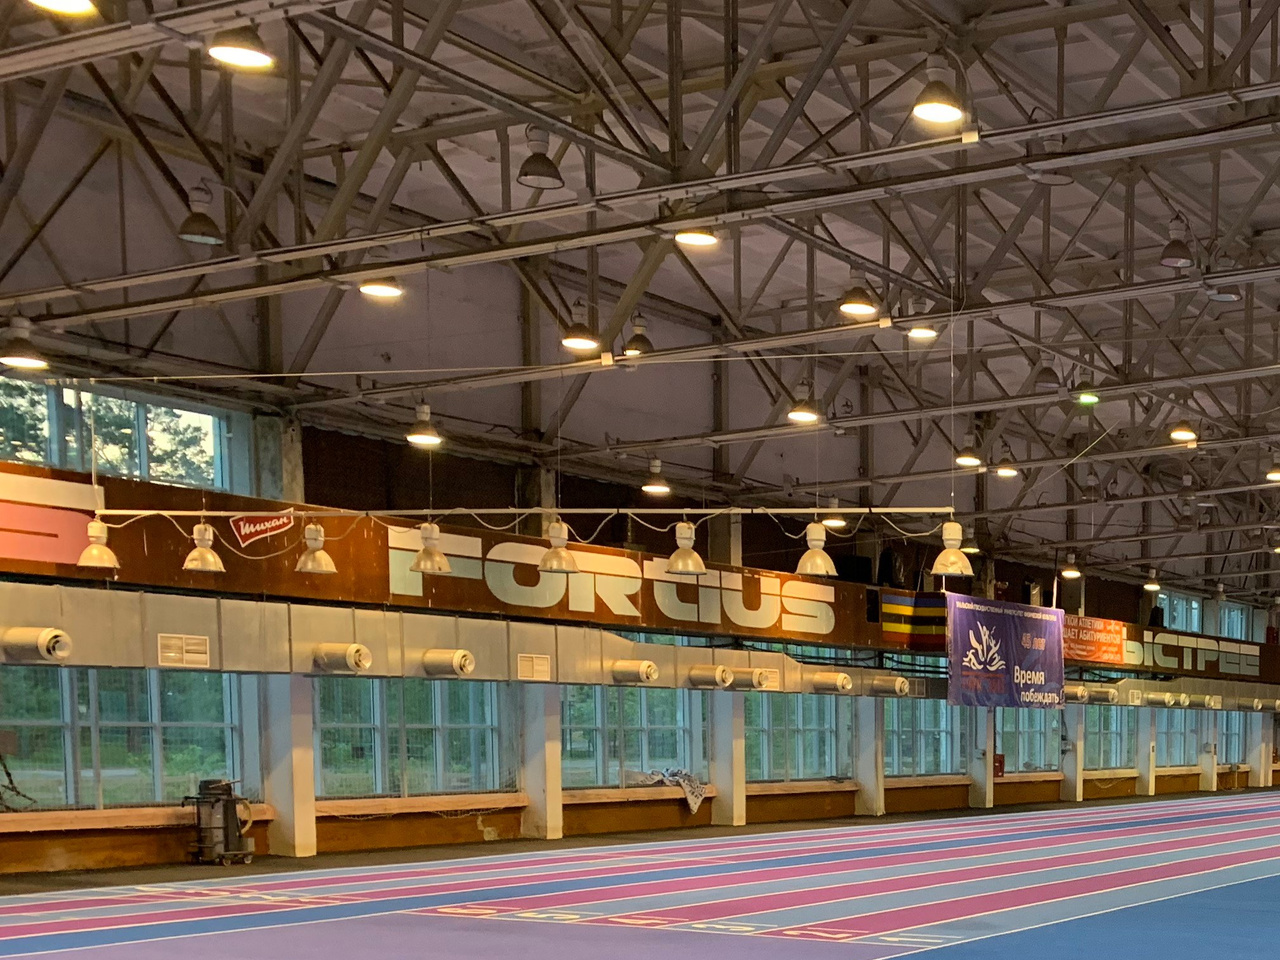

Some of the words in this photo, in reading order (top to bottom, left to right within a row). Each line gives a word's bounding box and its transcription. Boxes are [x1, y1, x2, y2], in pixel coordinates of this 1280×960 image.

[388, 526, 833, 634] FORTIUS
[1122, 626, 1260, 676] ЫСТРЕЕ
[1014, 665, 1045, 687] Время
[1020, 688, 1060, 705] побеждать
[783, 930, 853, 938] 2
